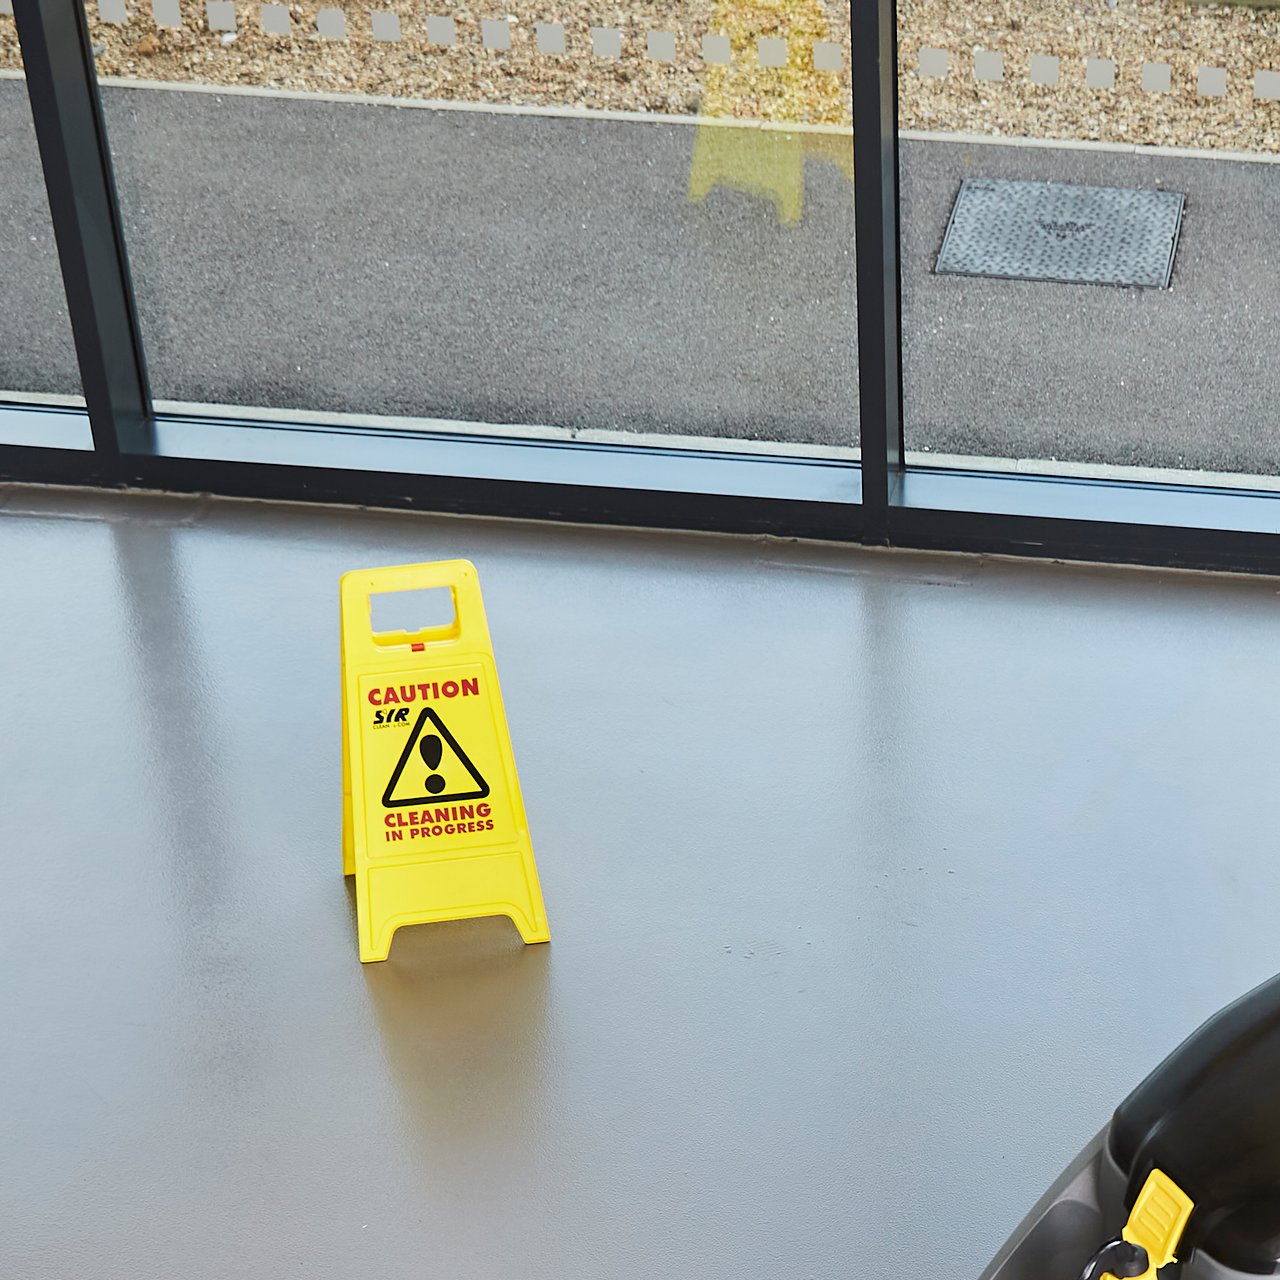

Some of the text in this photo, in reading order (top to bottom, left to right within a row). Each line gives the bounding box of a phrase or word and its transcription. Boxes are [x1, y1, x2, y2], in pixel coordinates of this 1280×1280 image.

[368, 678, 479, 706] CAUTION
[384, 803, 491, 827] CLEANING
[386, 819, 494, 842] IN PROGRESS
